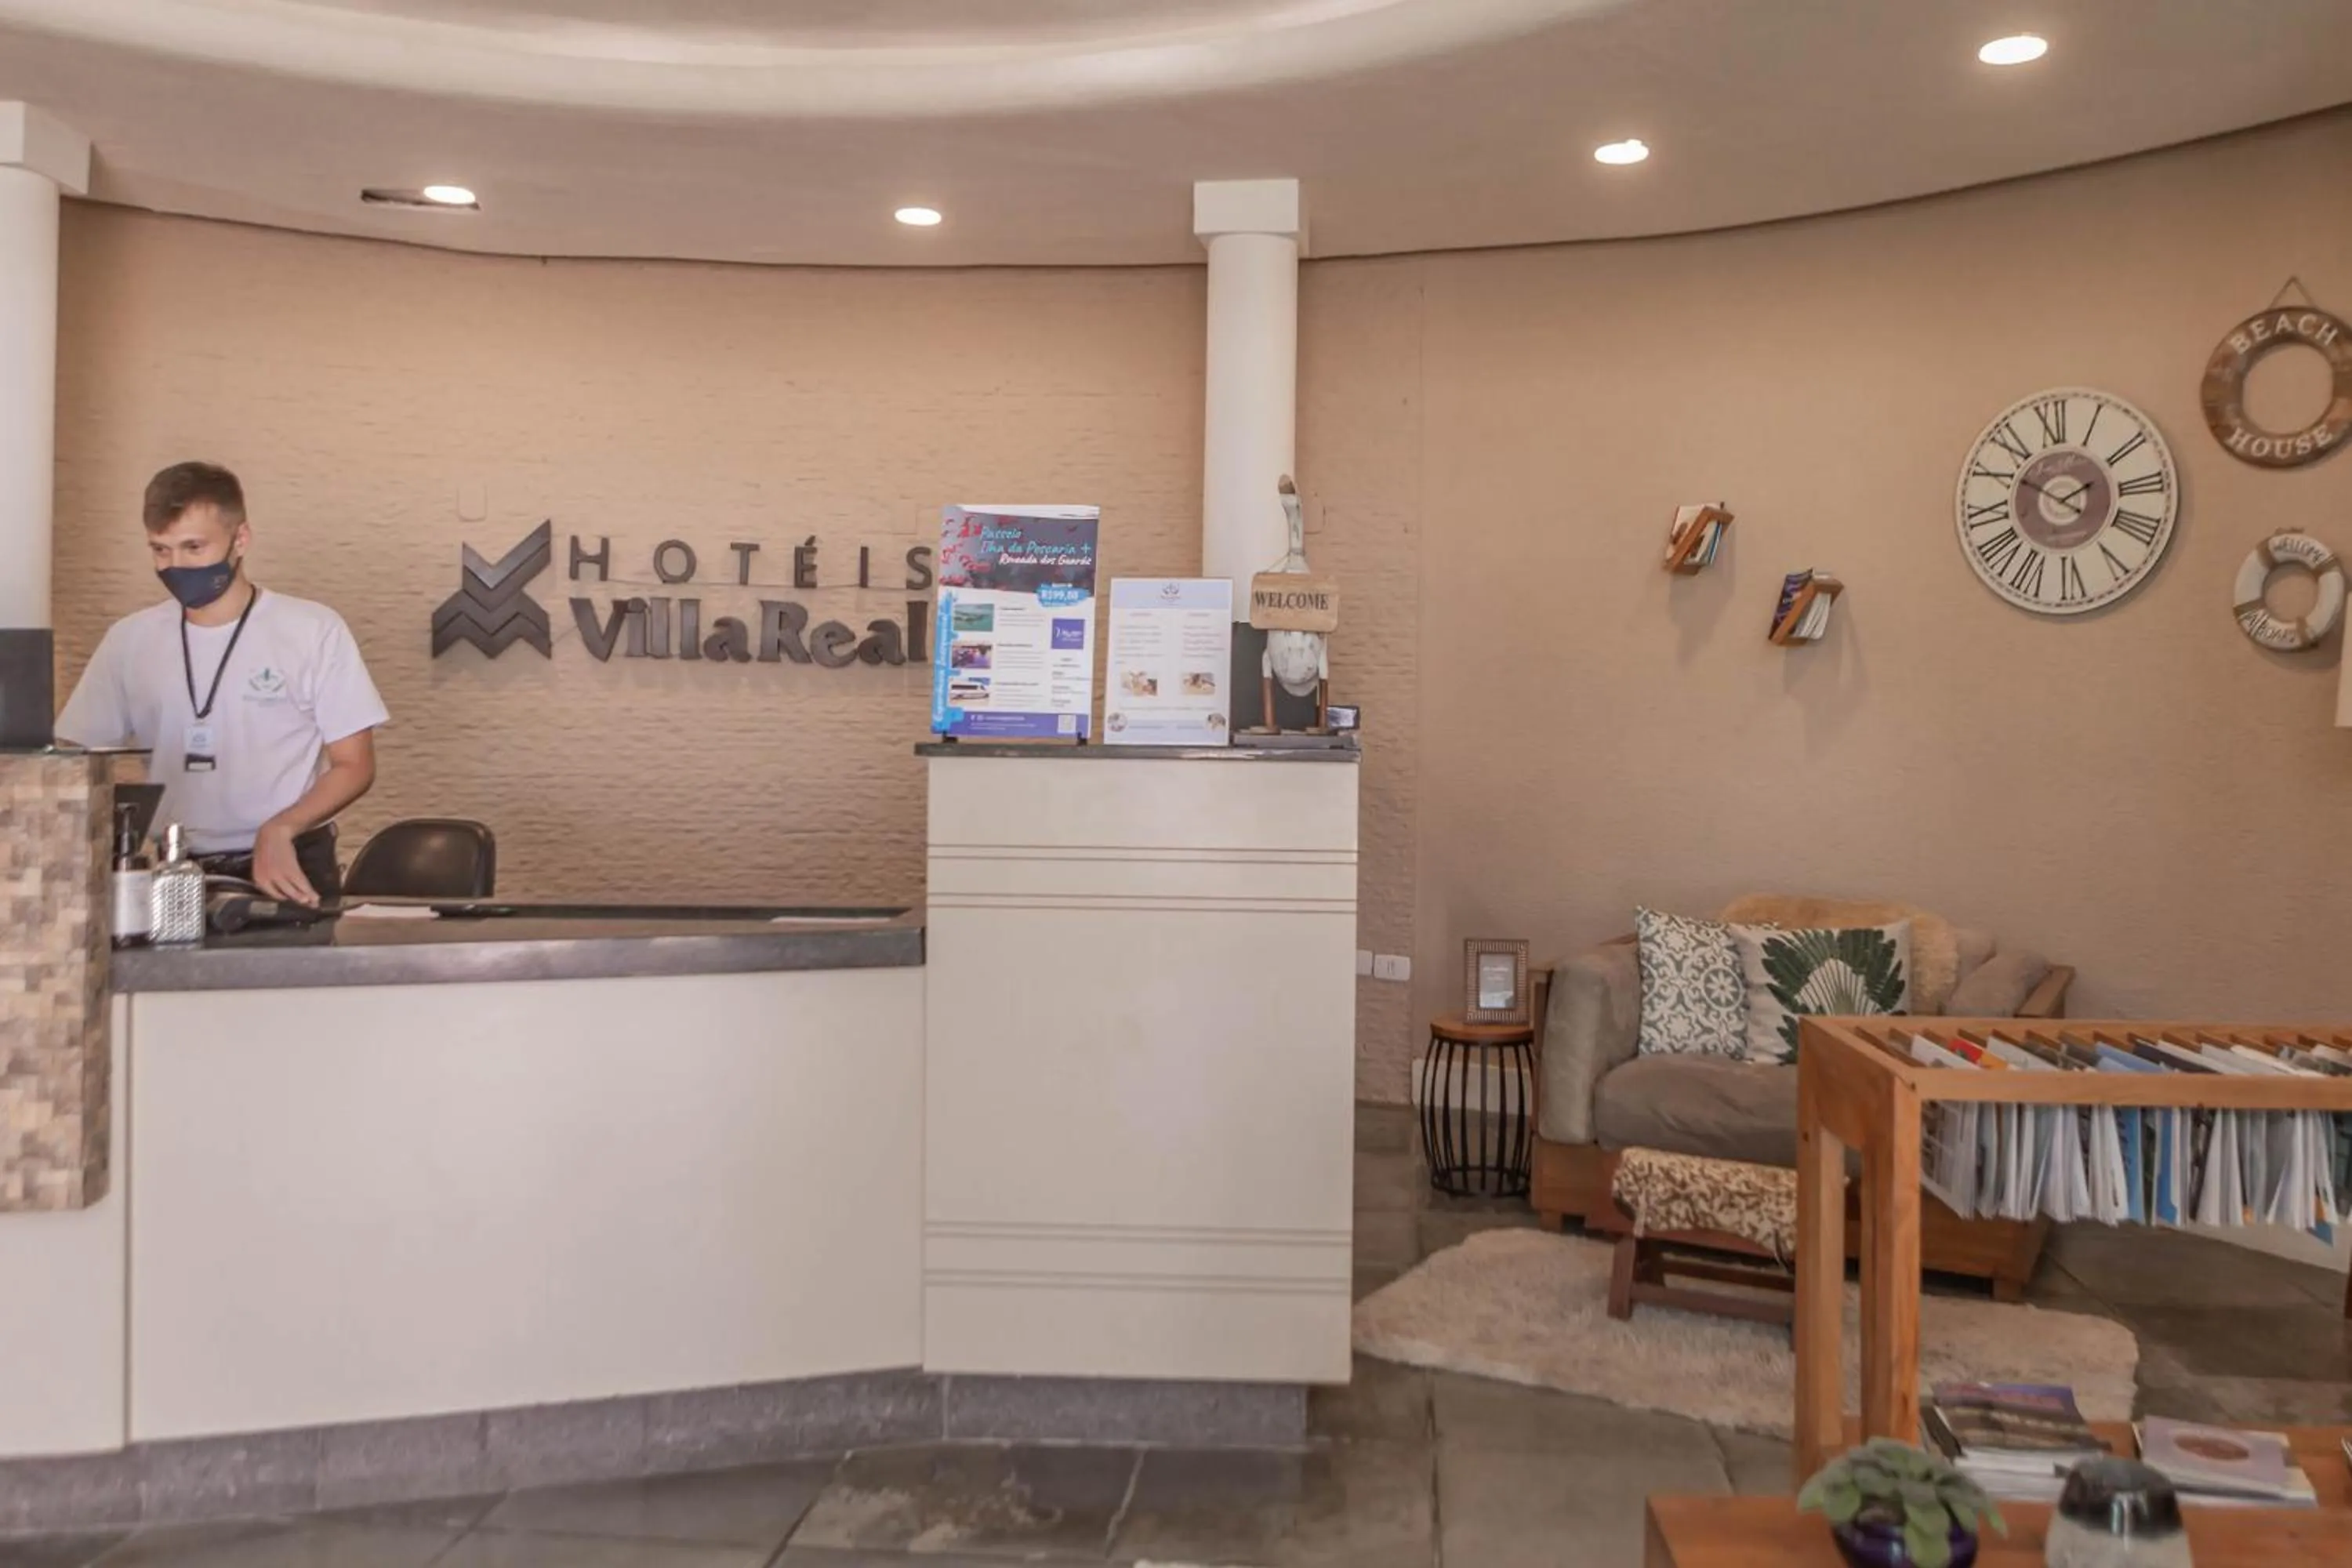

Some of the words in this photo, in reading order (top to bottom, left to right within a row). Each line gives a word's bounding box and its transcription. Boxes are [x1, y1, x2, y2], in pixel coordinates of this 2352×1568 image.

[2228, 314, 2339, 354] BEACH
[2034, 399, 2067, 449] XII
[2224, 424, 2333, 459] HOUSE
[568, 535, 932, 590] HOTÉIS
[1254, 590, 1330, 611] WELCOME
